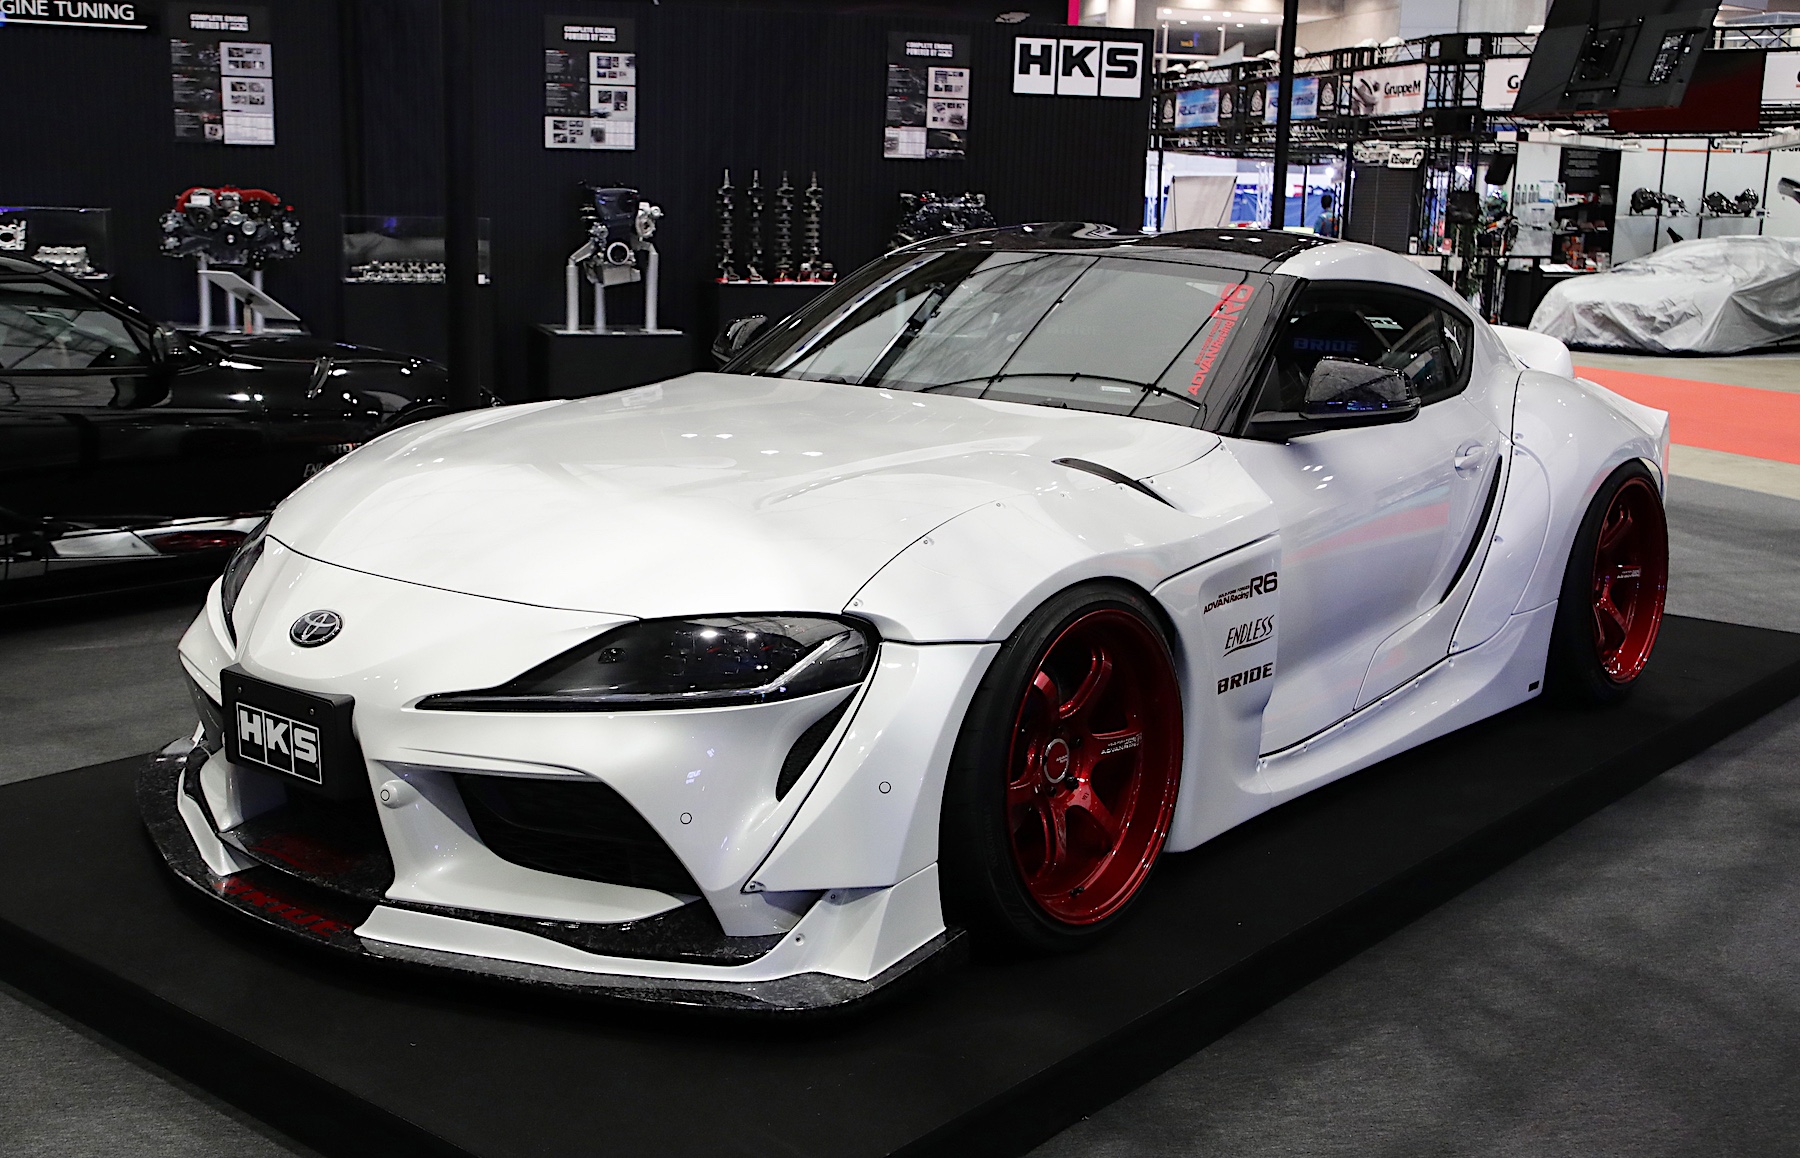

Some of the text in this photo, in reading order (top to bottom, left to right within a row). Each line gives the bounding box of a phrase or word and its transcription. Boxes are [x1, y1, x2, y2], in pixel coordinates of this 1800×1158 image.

[53, 1, 135, 20] TUNING
[1018, 43, 1139, 79] HKS
[1293, 338, 1359, 352] BRIDE
[1249, 571, 1278, 598] R6
[1225, 614, 1275, 650] ENDLESS
[1217, 661, 1274, 696] BRIDE
[240, 709, 318, 765] HKS
